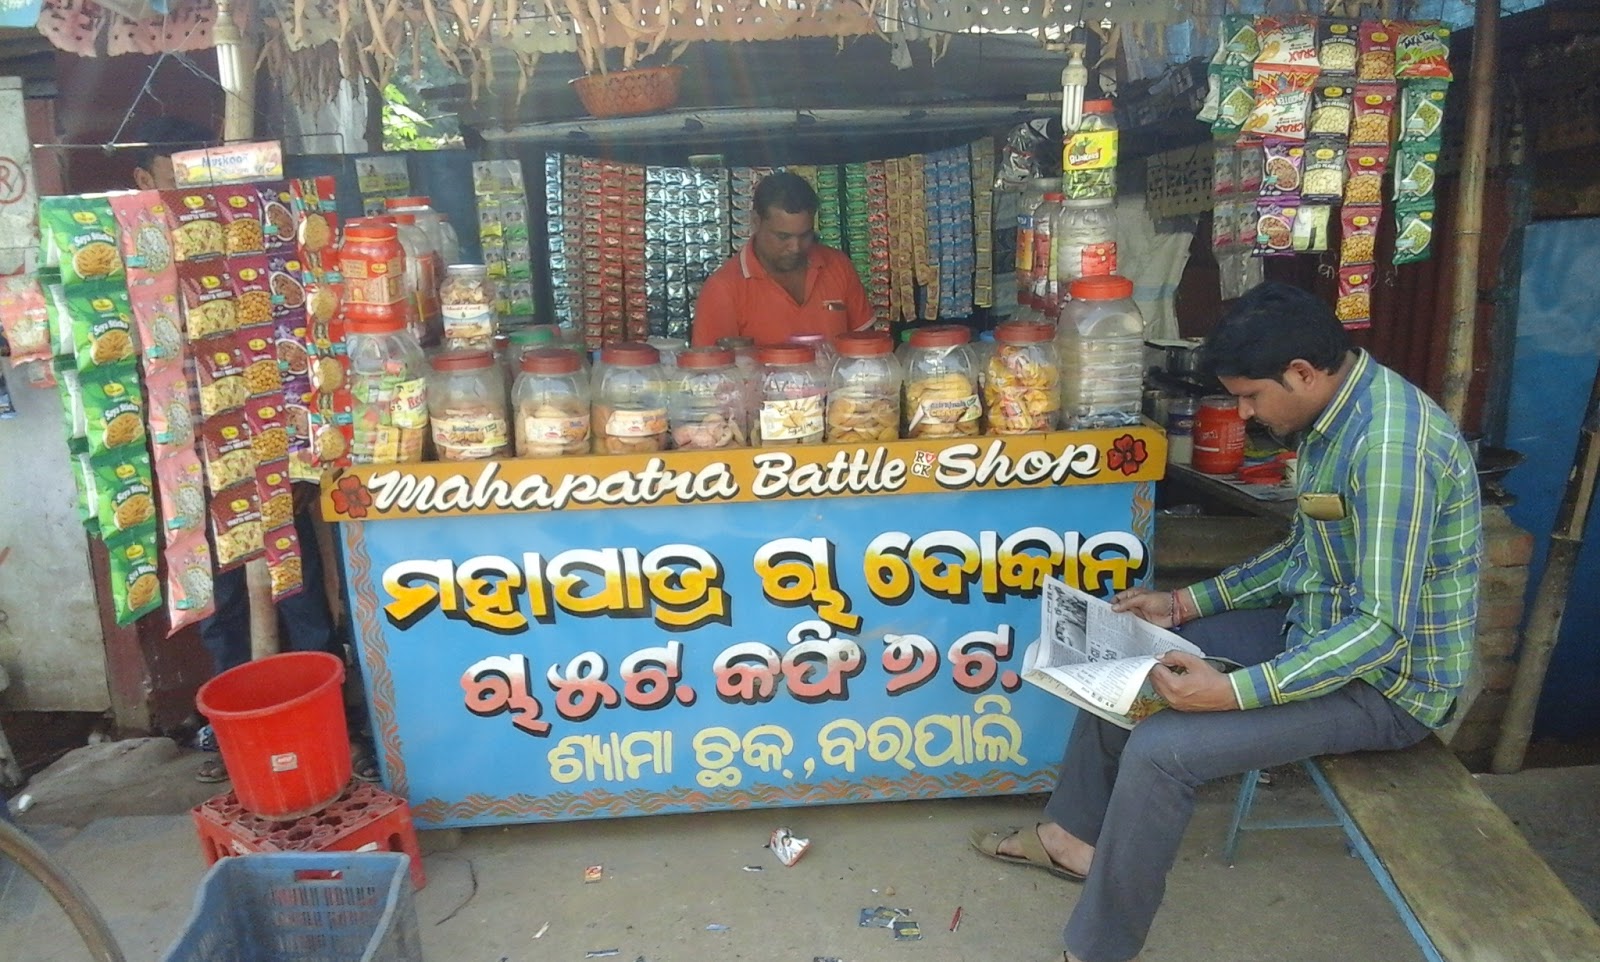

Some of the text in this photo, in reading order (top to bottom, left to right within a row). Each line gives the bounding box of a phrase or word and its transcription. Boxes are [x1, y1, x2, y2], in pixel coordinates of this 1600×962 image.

[1288, 47, 1317, 63] CRAX
[1274, 122, 1304, 134] CRAX
[751, 446, 908, 498] Battle
[934, 440, 1102, 488] Shop
[382, 543, 730, 632] ମହାପାତ୍ର
[864, 526, 1149, 600] ଦୋକାନ
[713, 619, 864, 702] କଫି
